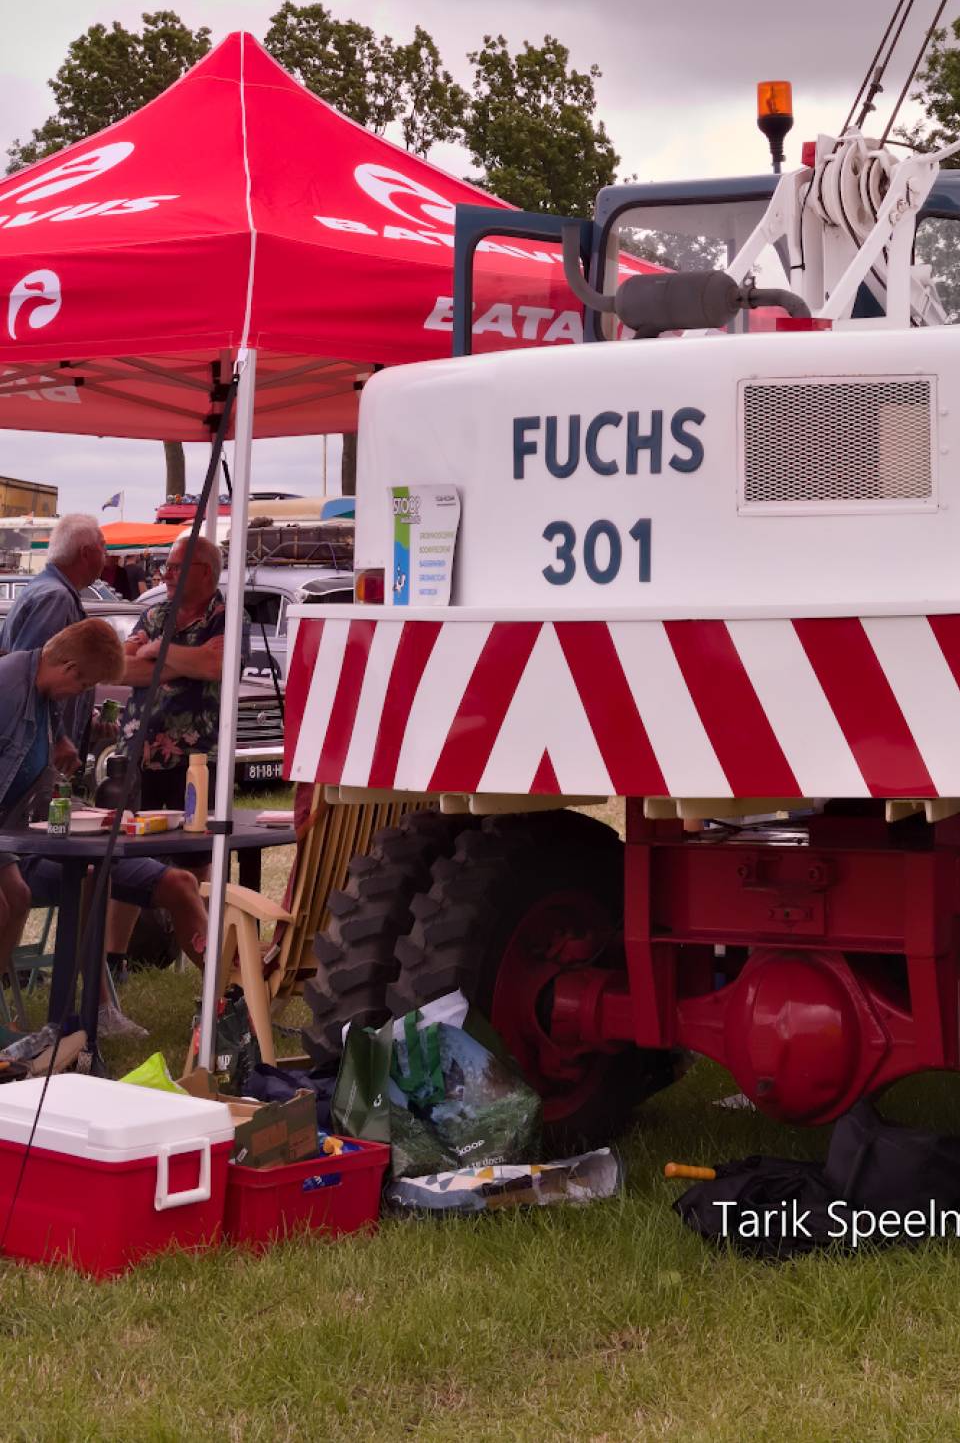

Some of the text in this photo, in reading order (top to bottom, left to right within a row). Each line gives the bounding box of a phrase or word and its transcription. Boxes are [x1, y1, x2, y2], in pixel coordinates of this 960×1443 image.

[0, 194, 181, 229] VUS
[513, 407, 706, 480] FUCHS
[542, 518, 652, 586] 301
